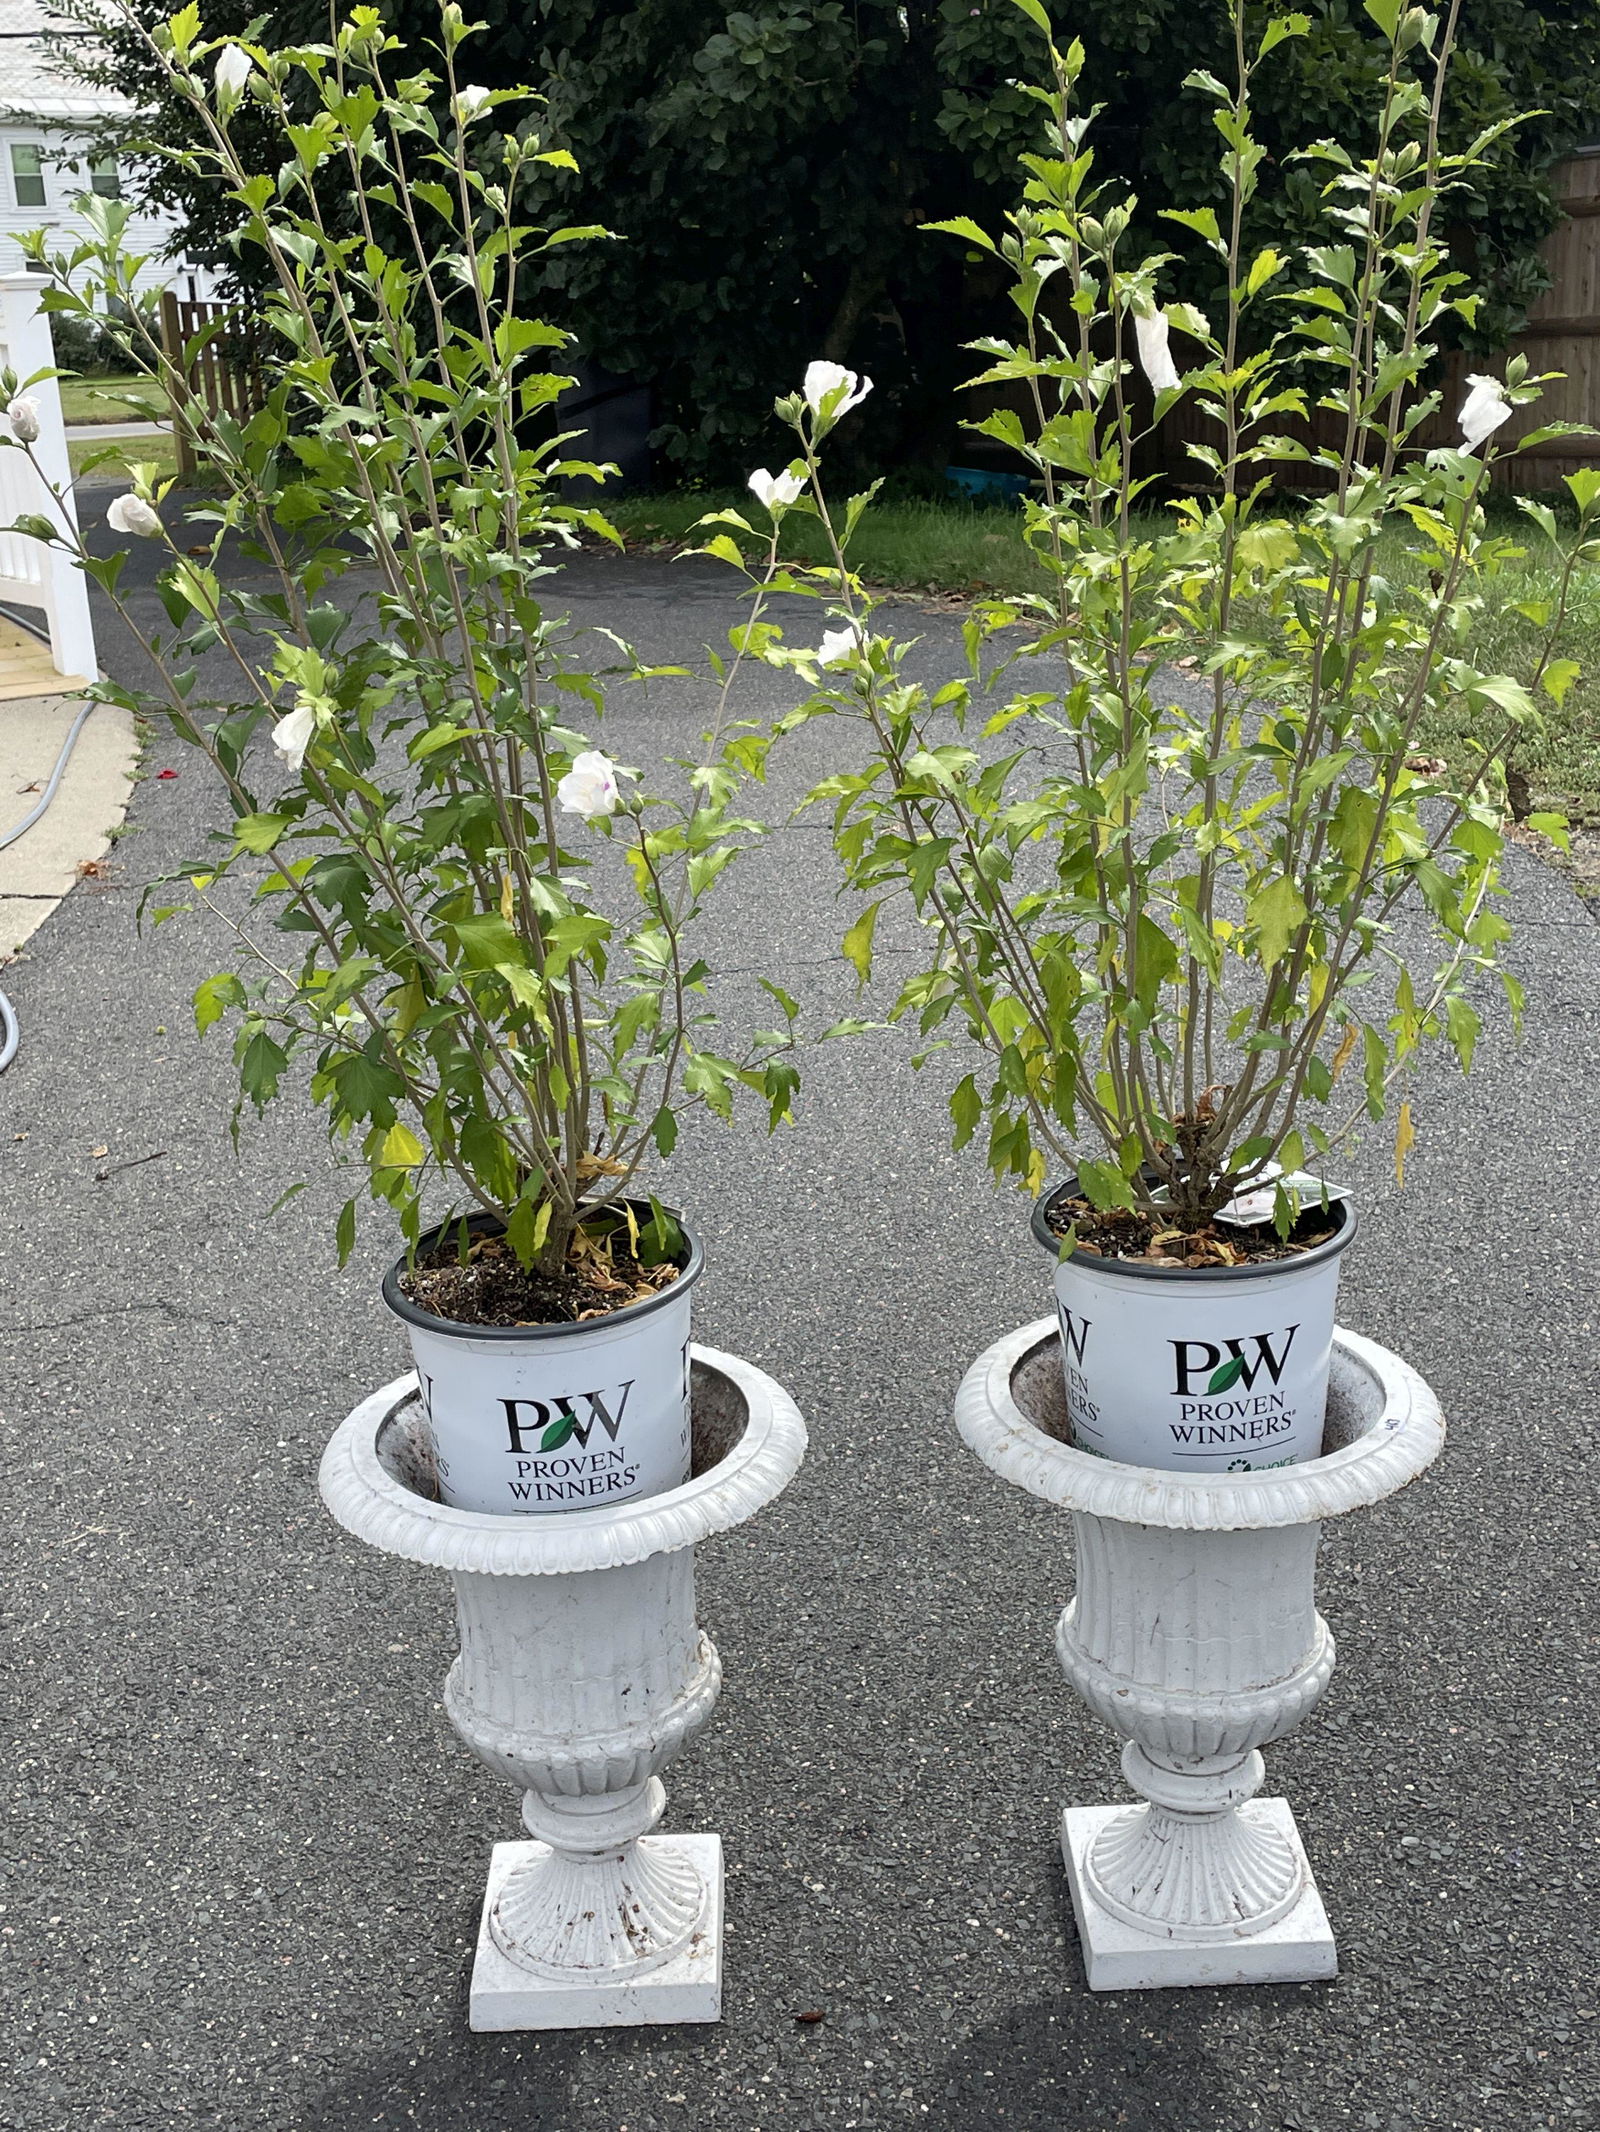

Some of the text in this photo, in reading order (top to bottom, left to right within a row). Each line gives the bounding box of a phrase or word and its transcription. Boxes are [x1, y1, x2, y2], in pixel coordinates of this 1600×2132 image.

[1166, 1323, 1301, 1397] PW
[496, 1379, 636, 1454] PW
[1180, 1390, 1286, 1421] PROVEN
[1169, 1411, 1292, 1444] WINNERS
[516, 1446, 625, 1478] PROVEN
[508, 1465, 636, 1501] WINNERS
